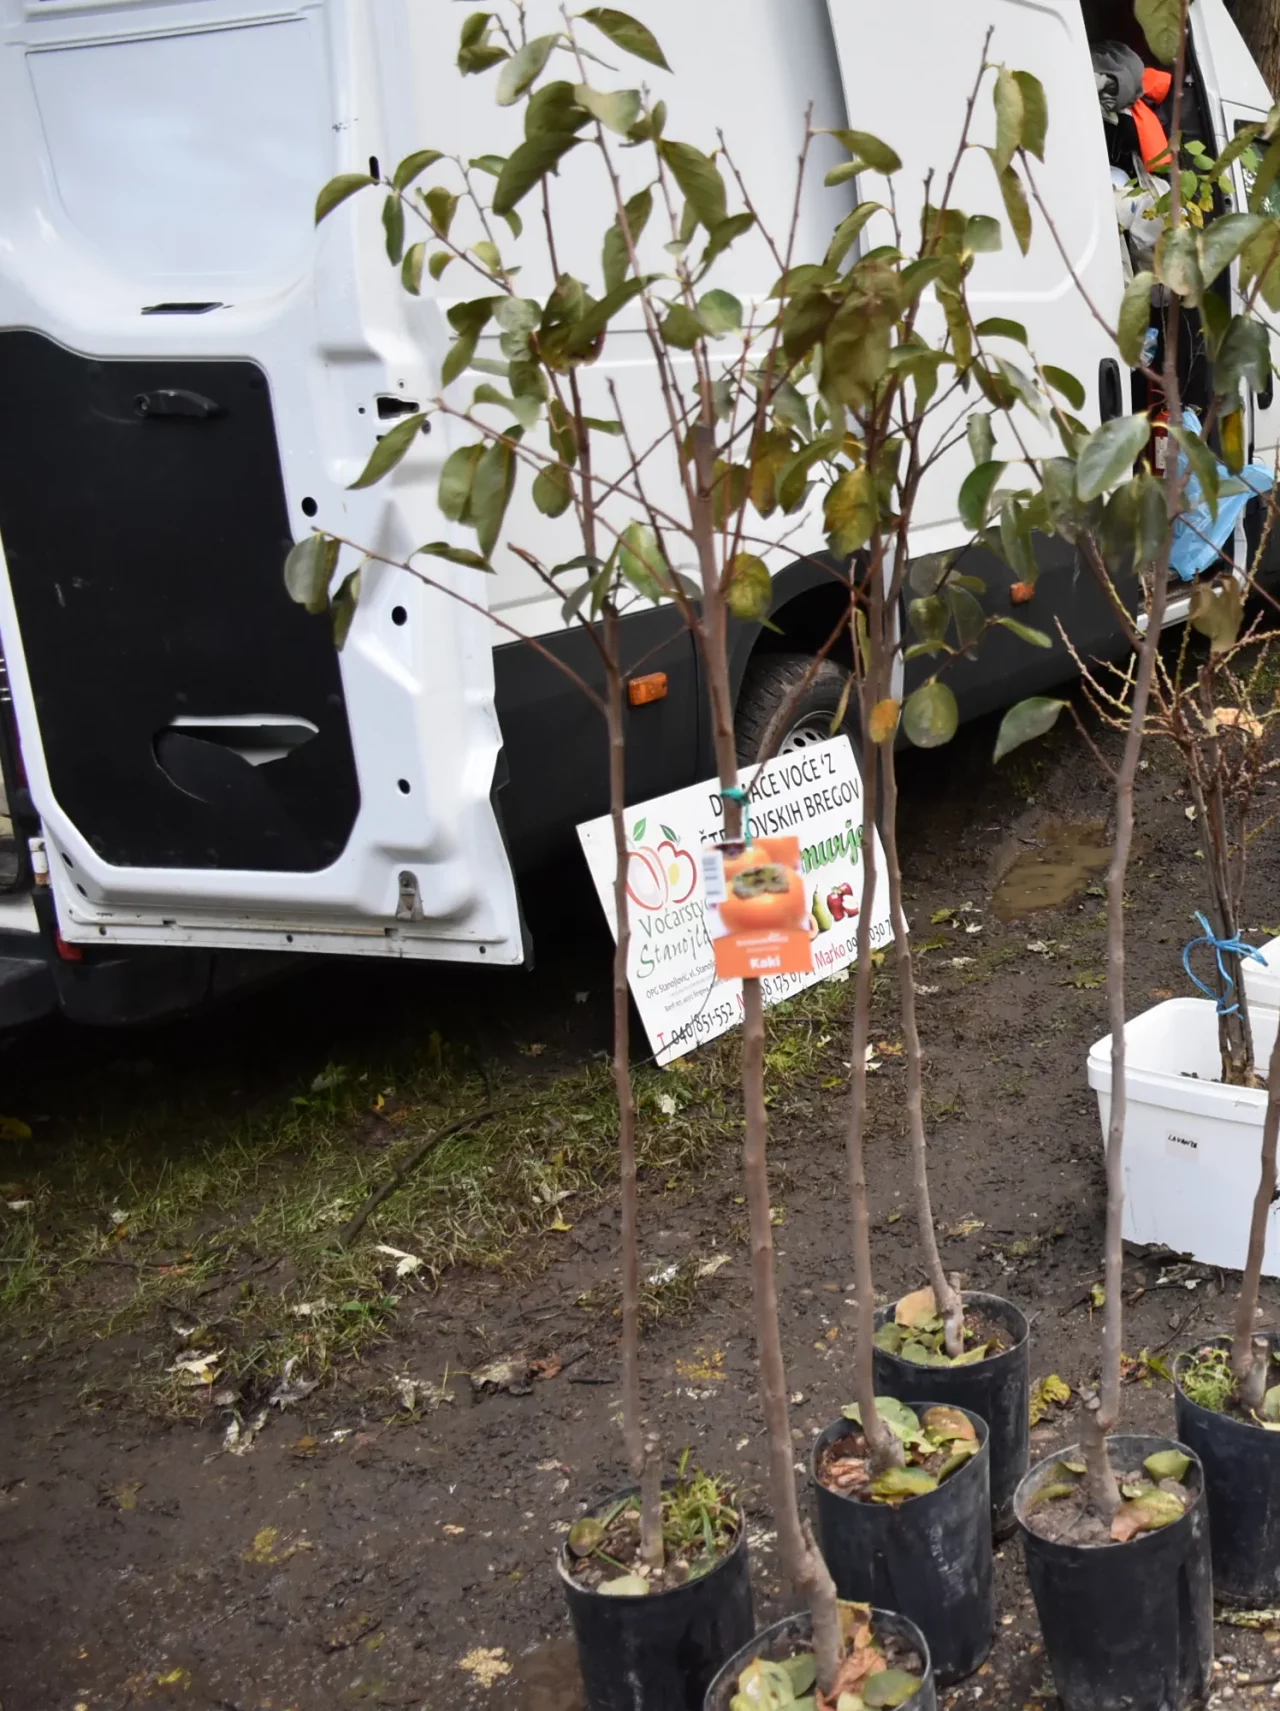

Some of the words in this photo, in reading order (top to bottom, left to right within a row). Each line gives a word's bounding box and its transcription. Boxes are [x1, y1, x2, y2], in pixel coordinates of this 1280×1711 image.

[779, 755, 821, 790] VOĆE
[804, 778, 860, 818] BREGOV
[814, 942, 846, 968] Marko
[646, 986, 660, 999] OPG
[671, 1002, 734, 1045] 040/851-552
[773, 973, 790, 993] 175
